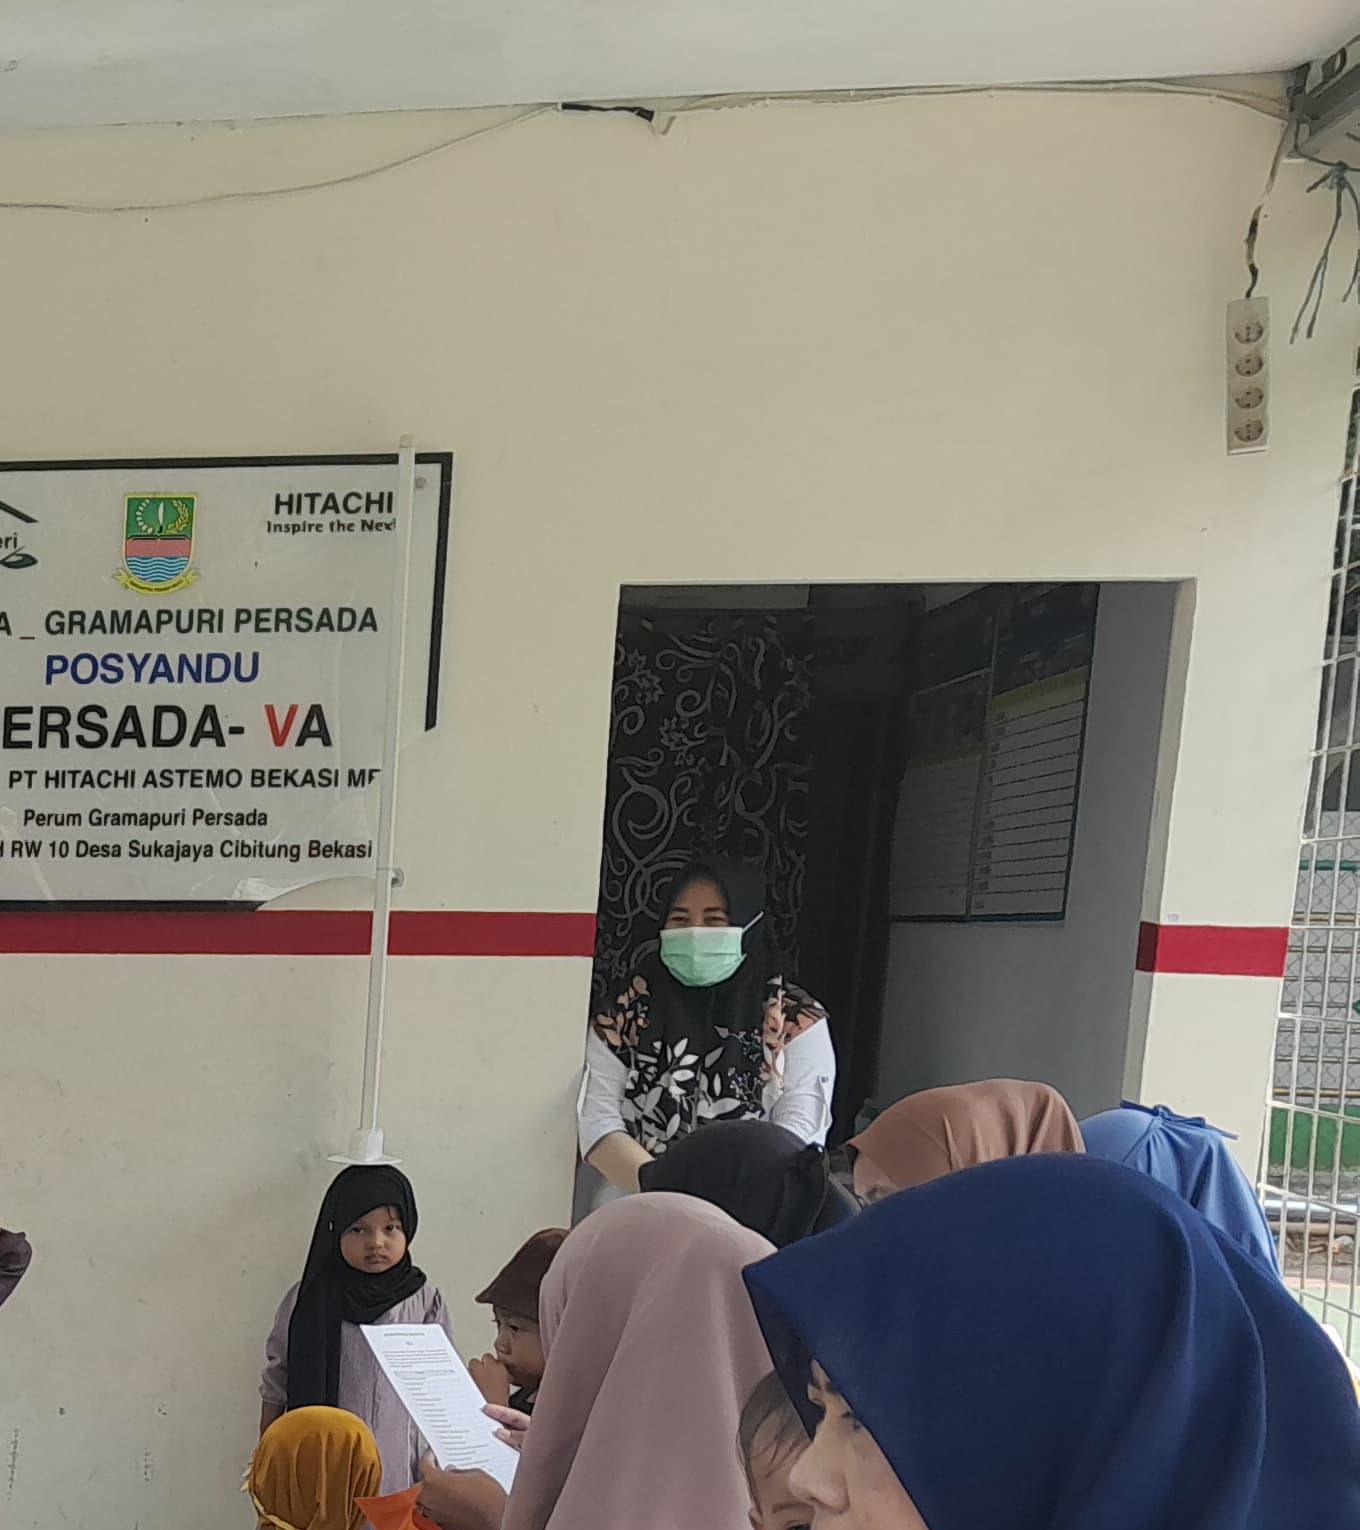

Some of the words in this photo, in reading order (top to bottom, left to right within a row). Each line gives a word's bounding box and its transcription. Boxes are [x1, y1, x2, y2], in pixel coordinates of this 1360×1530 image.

[274, 491, 394, 515] HITACHI
[266, 520, 324, 535] Inspire
[329, 519, 356, 533] the
[44, 609, 224, 635] GRAMAPURI
[233, 607, 379, 633] PERSADA
[45, 652, 260, 685] POSYANDU
[264, 704, 333, 748] VA
[8, 770, 37, 788] PT
[44, 769, 136, 788] HITACHI
[142, 769, 243, 789] ASTEMO
[250, 768, 339, 788] BEKASI
[23, 809, 82, 827] Perum
[88, 808, 186, 830] Gramapuri
[192, 808, 268, 827] Persada
[11, 841, 42, 858] RW
[49, 840, 70, 858] 10
[75, 840, 122, 858] Desa
[128, 839, 214, 862] Sukajaya
[219, 839, 301, 863] Cibitung
[307, 839, 373, 859] Bekasi
